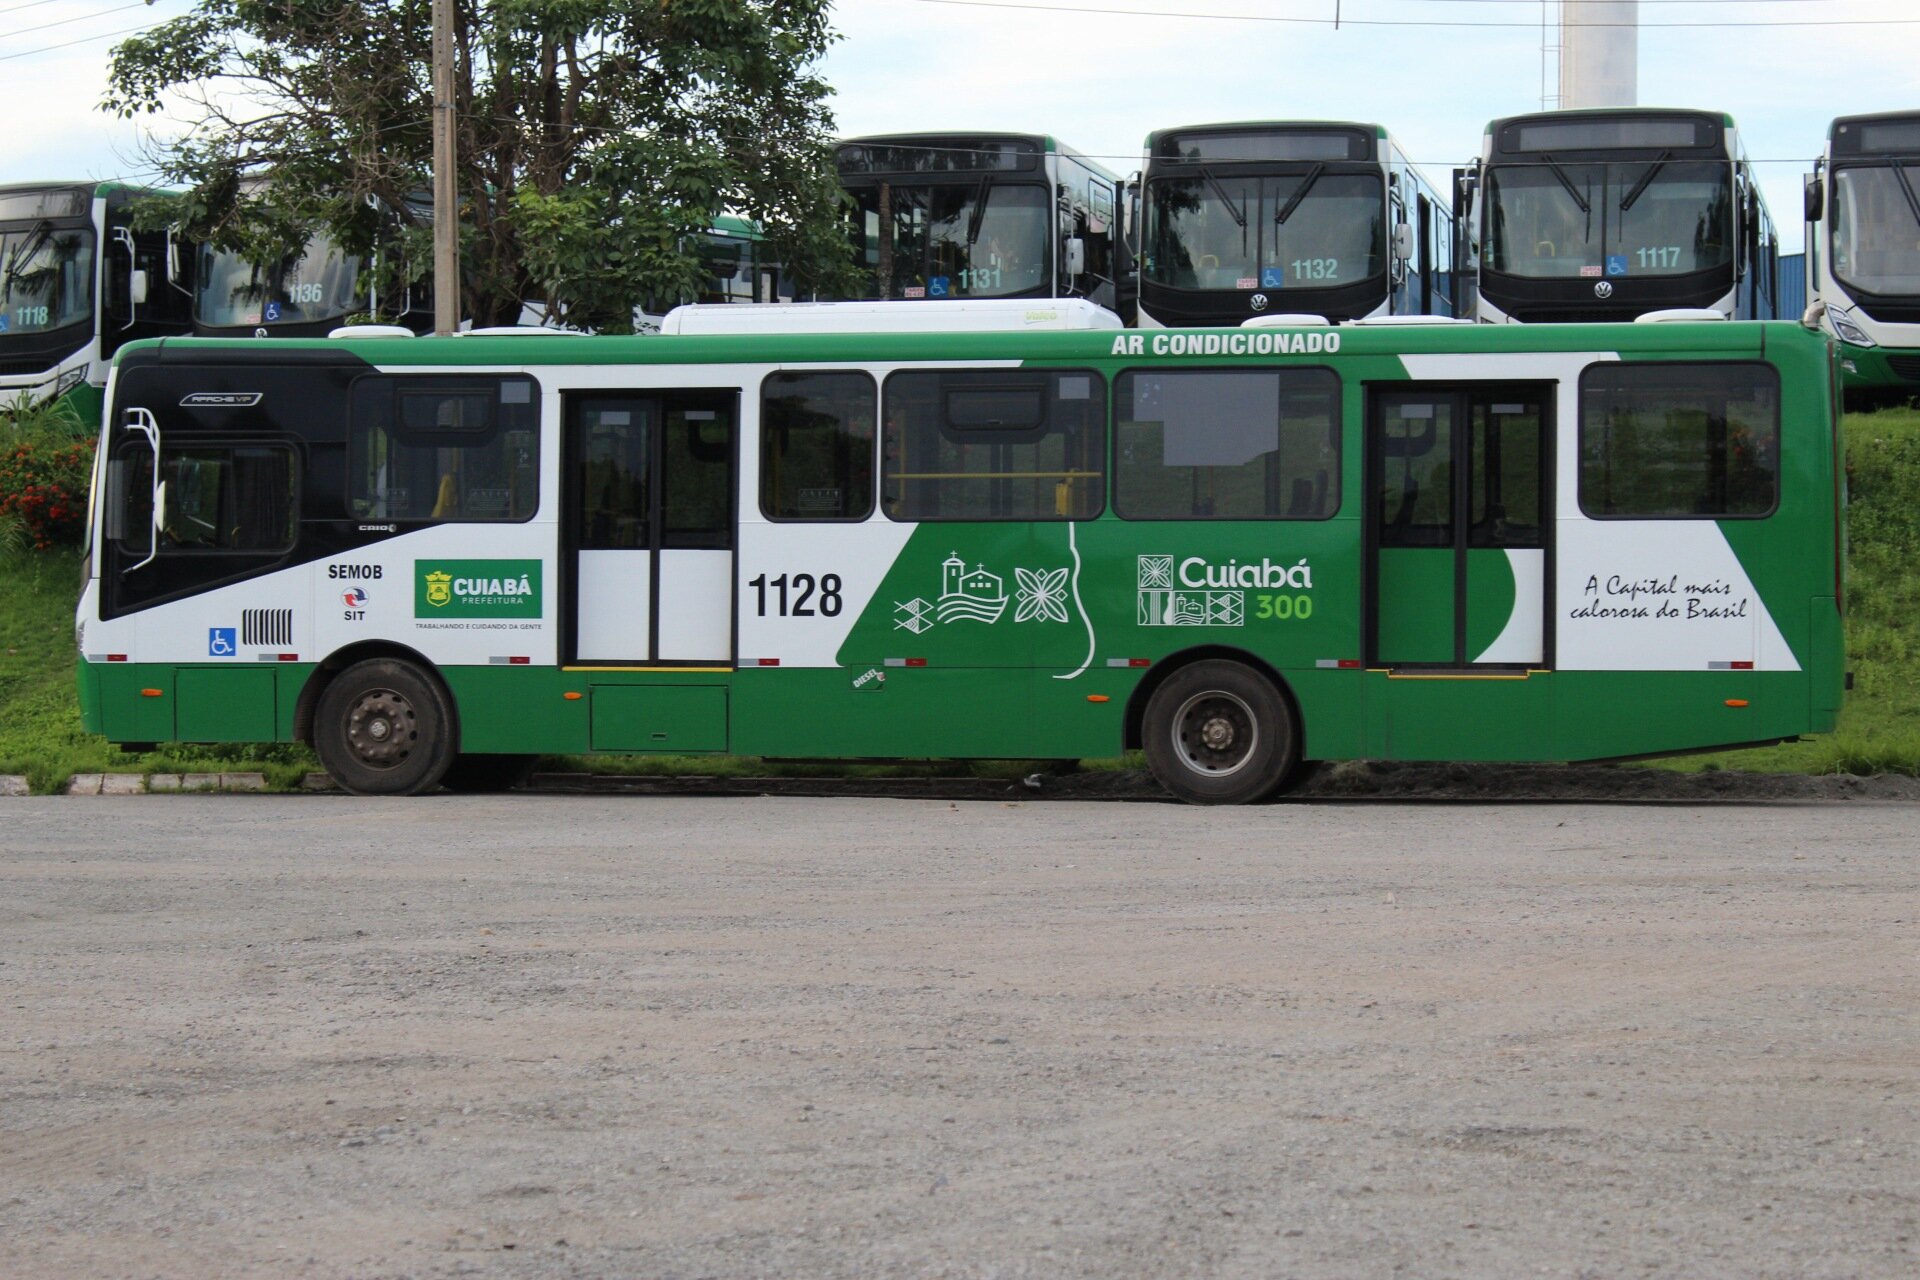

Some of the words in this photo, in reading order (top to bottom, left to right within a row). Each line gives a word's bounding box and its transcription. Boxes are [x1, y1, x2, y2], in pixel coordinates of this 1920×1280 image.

[1636, 247, 1681, 268] 1117
[958, 268, 1001, 289] 1131
[1291, 258, 1338, 280] 1132
[289, 283, 322, 303] 1136
[16, 306, 49, 325] 1118
[1111, 335, 1145, 355] AR
[1152, 332, 1341, 356] CONDICIONADO
[328, 564, 383, 579] SEMOB
[1179, 556, 1313, 589] Cuiabá
[453, 574, 533, 596] CUIABÁ
[748, 573, 843, 617] 1128
[1584, 574, 1599, 596] A
[1606, 574, 1678, 601] Capital
[1683, 578, 1732, 595] mais
[462, 597, 524, 605] PREFEITURA
[1255, 595, 1313, 619] 300
[1570, 598, 1649, 619] calorosa
[1655, 599, 1680, 618] do
[1686, 598, 1748, 620] Brasil
[344, 610, 366, 621] SIT
[853, 668, 878, 688] DIESEL
